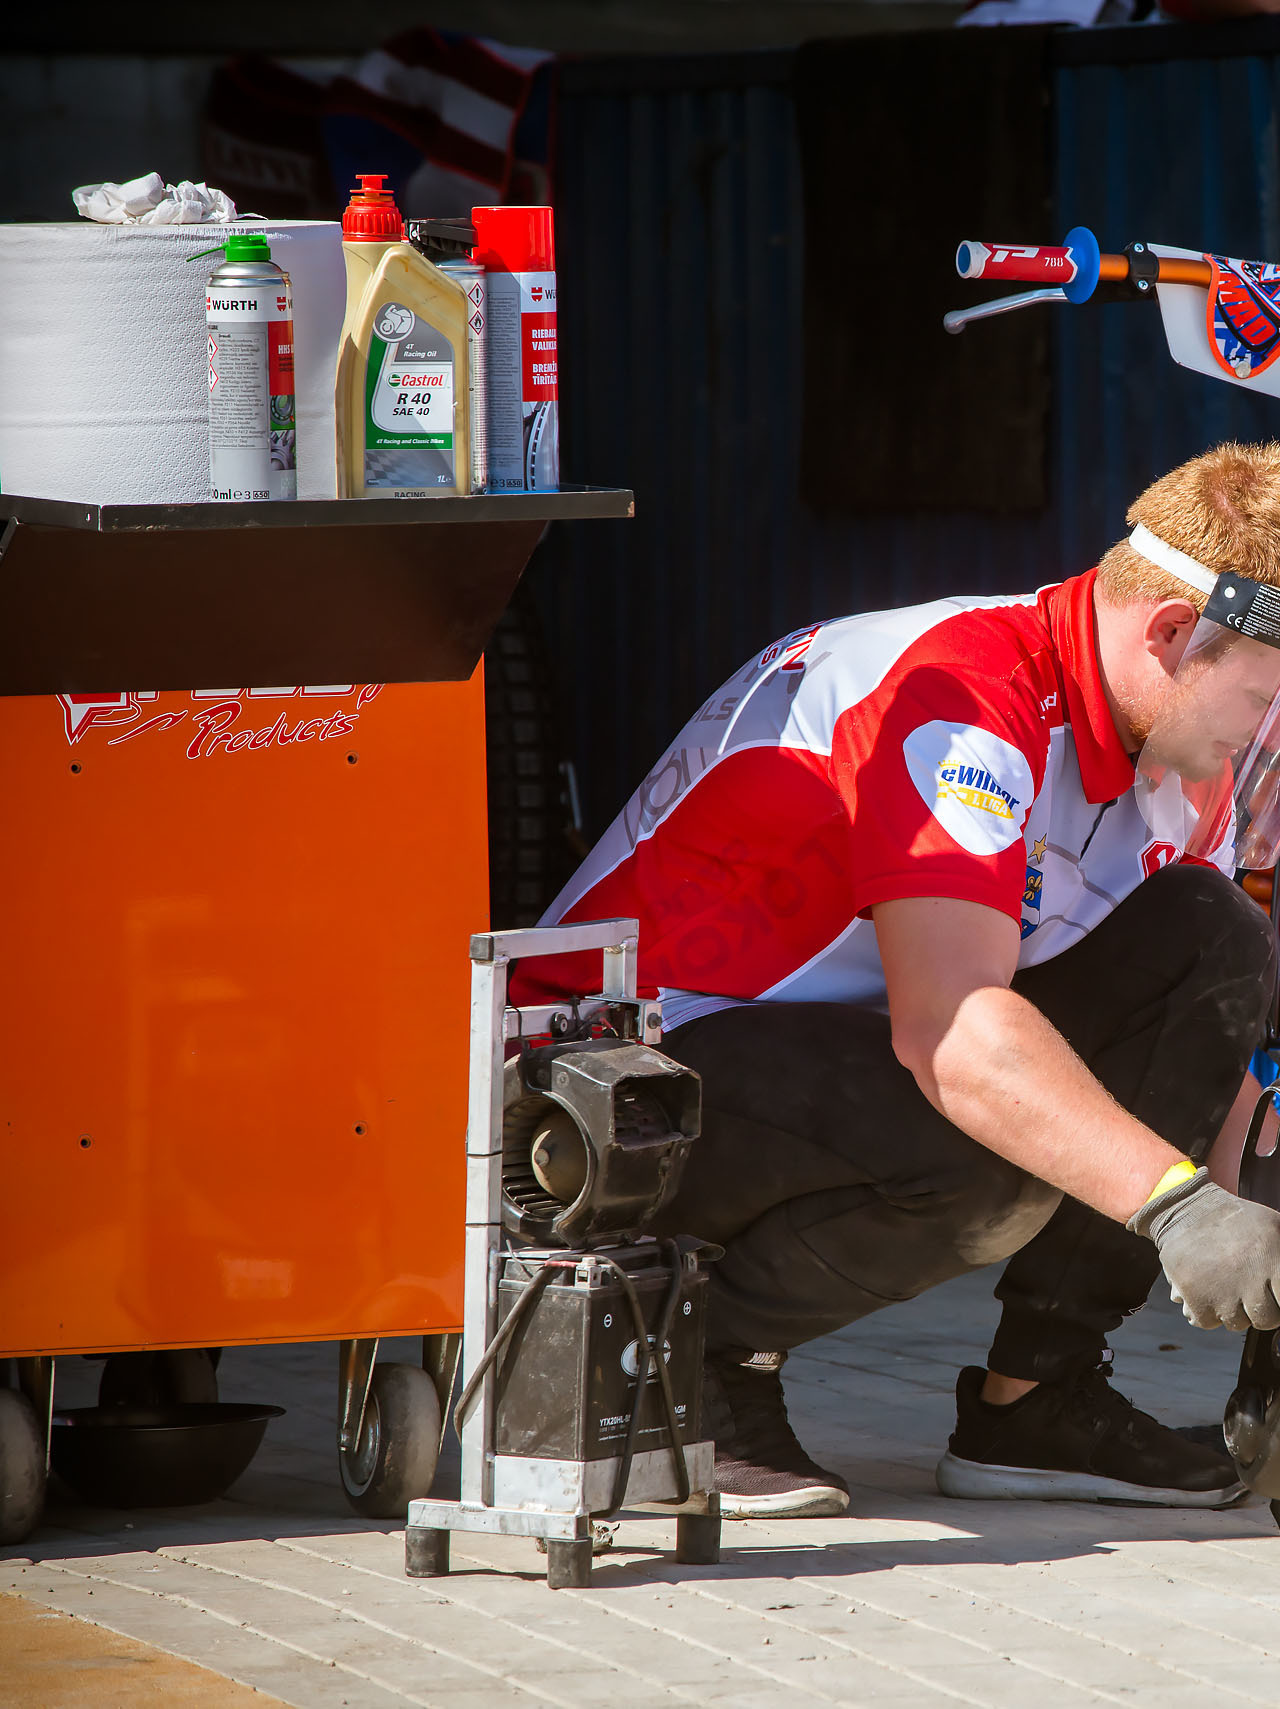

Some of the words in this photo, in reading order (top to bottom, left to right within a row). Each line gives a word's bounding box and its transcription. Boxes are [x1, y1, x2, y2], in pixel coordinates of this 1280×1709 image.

[1044, 257, 1064, 267] 788
[403, 350, 426, 358] Racing
[426, 350, 437, 358] Oil
[401, 374, 444, 387] Castrol
[397, 393, 408, 405] R
[410, 393, 431, 405] 40
[393, 407, 415, 416] SAE
[416, 407, 430, 416] 40
[394, 491, 427, 499] RACING
[186, 700, 361, 760] Products
[982, 797, 1008, 816] LIGA
